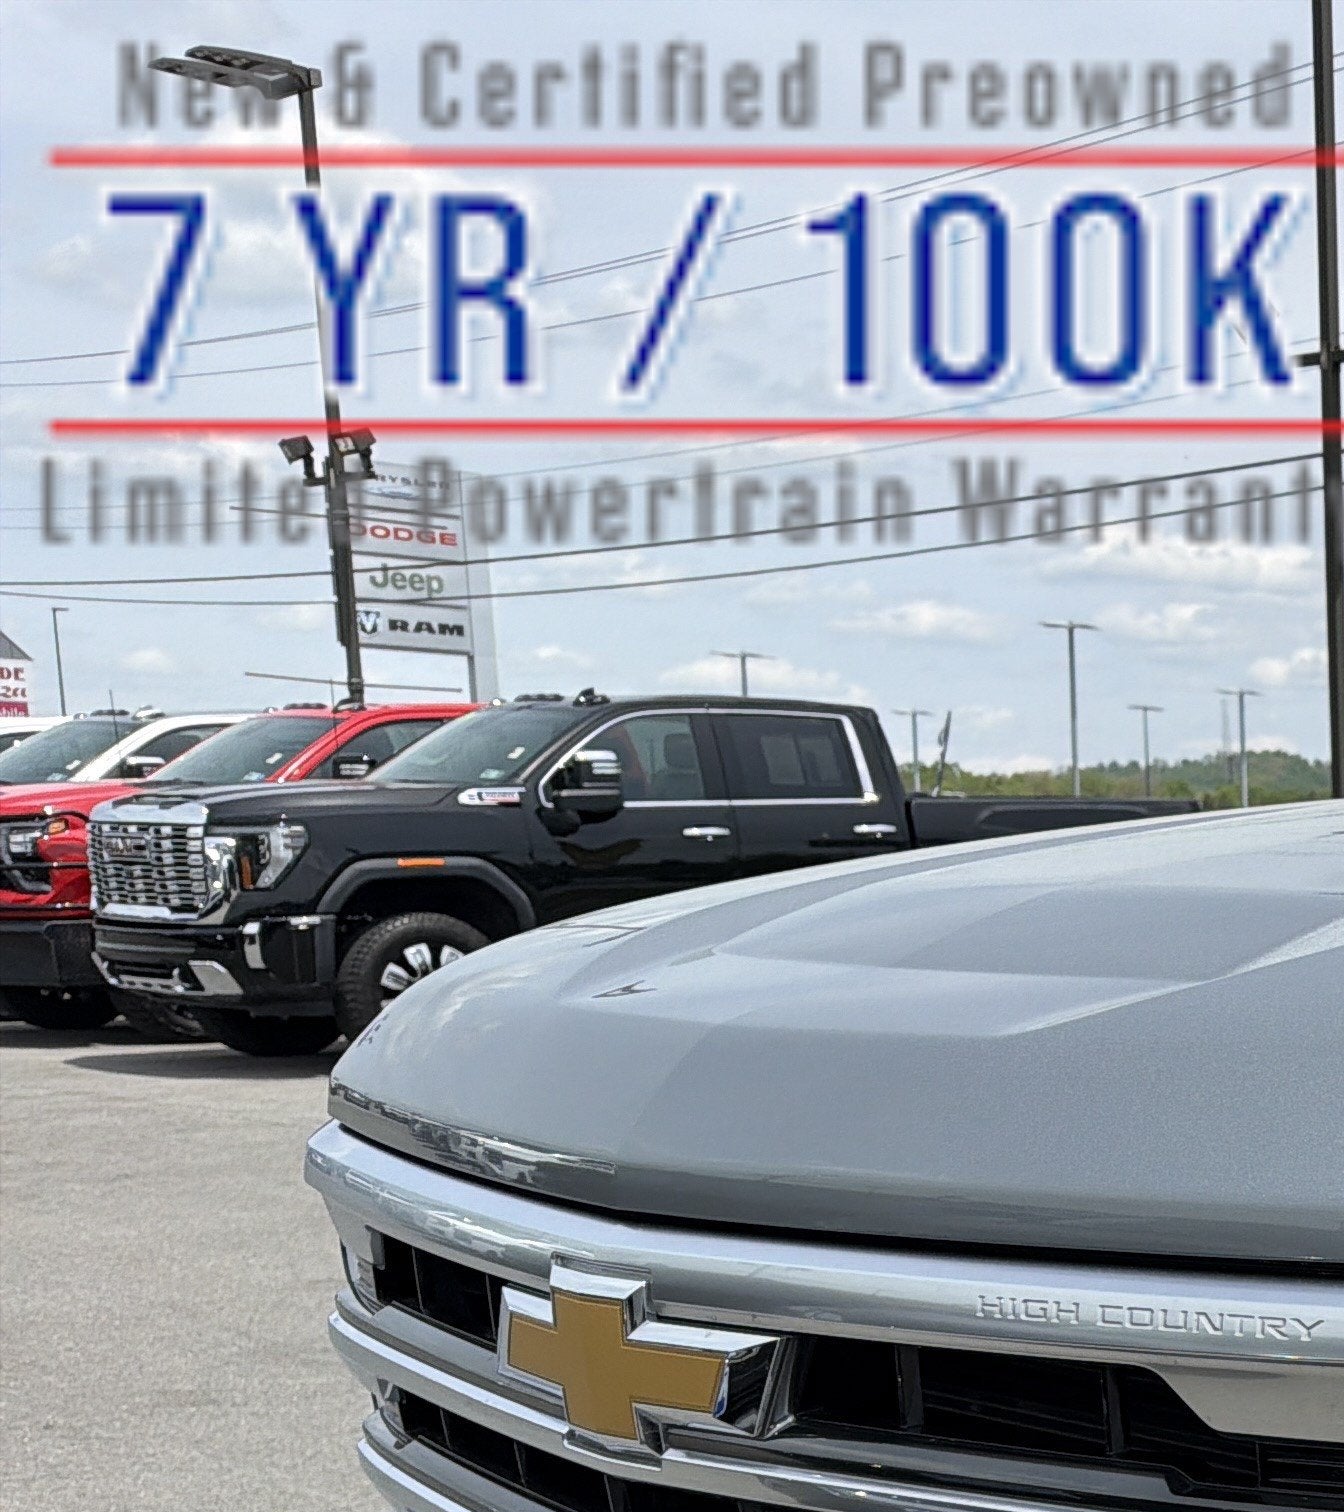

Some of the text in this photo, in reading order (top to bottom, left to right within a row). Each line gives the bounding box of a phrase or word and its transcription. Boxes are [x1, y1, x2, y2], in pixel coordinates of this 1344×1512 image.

[348, 522, 459, 547] DODGE
[369, 562, 445, 598] Jeep
[387, 617, 466, 639] RAM
[974, 1294, 1325, 1342] HIGH COUNTRY
